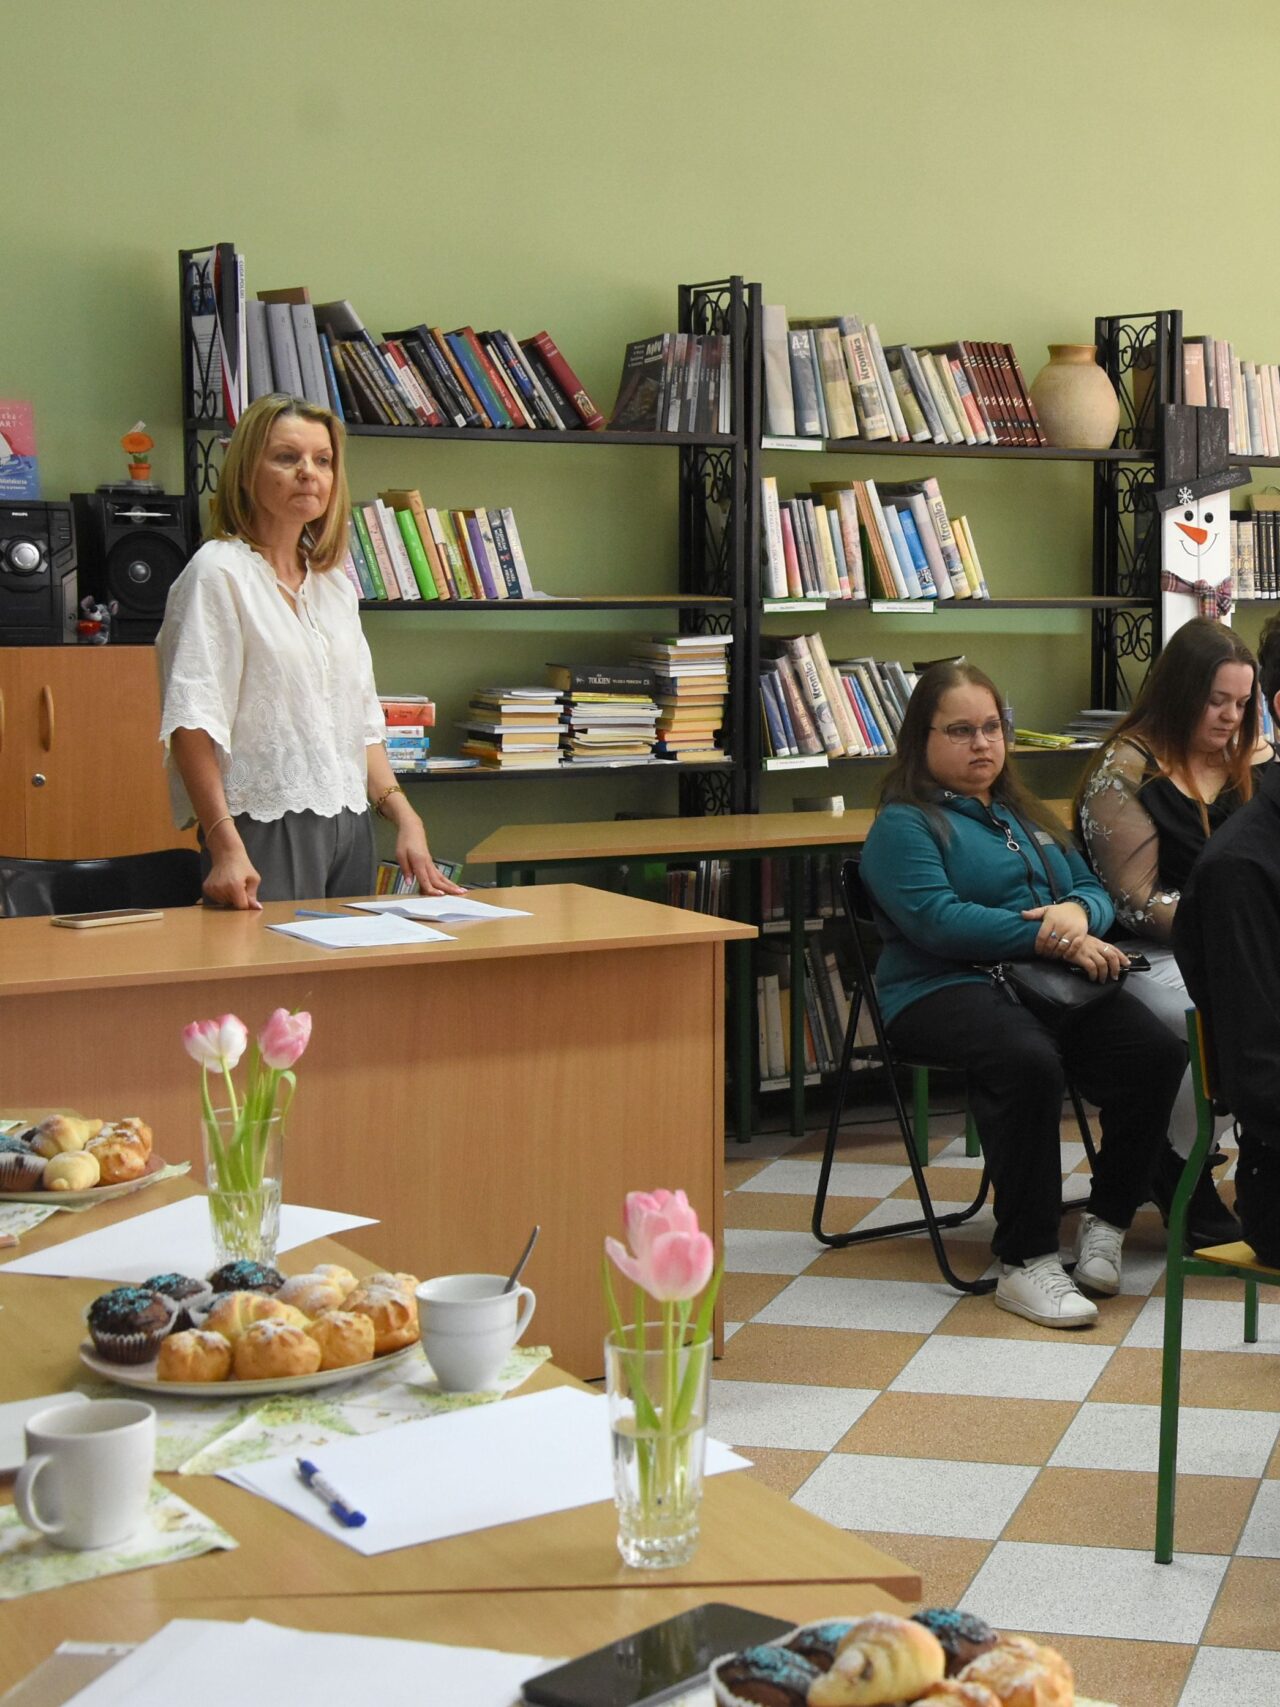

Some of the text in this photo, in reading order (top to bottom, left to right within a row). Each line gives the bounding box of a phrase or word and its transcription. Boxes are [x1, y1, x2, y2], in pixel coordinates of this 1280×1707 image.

[854, 338, 870, 380] Kronika
[935, 502, 952, 542] Kronika
[804, 661, 822, 700] Kronika
